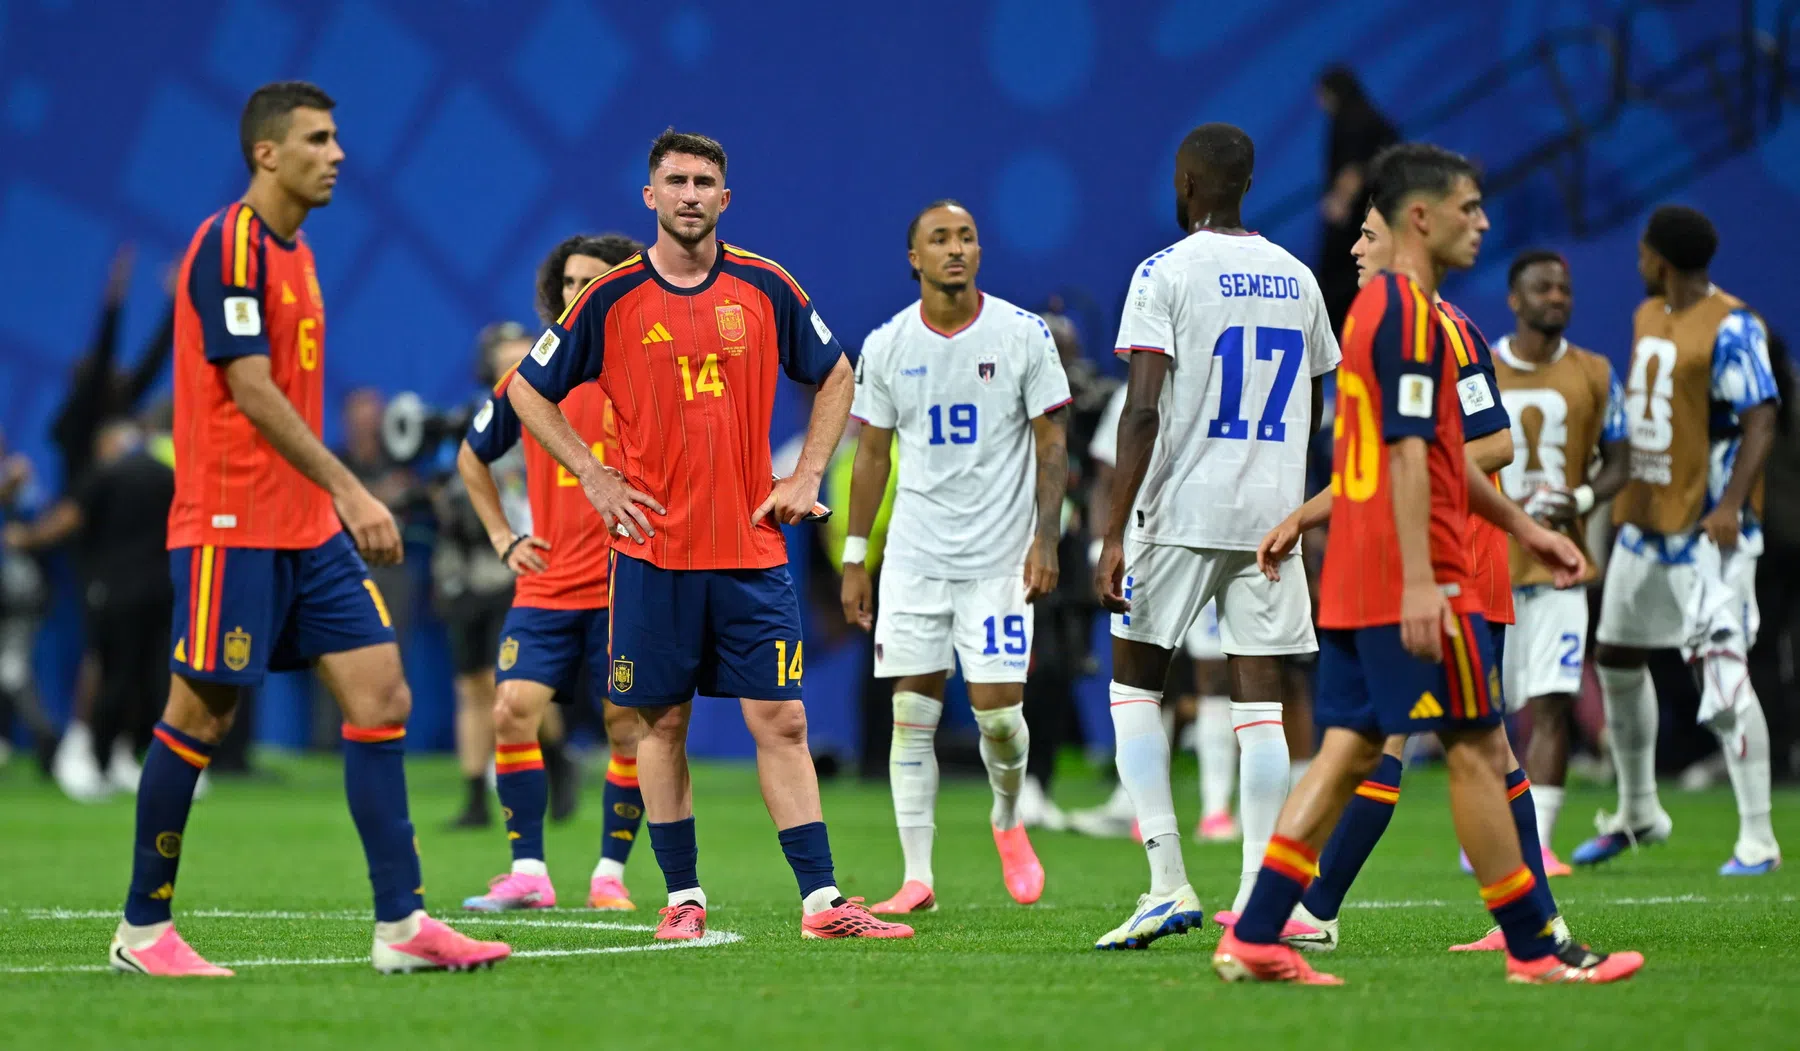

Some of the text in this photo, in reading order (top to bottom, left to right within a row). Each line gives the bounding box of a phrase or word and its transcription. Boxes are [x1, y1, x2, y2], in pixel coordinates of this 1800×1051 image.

[1219, 273, 1300, 300] SEMEDO
[677, 353, 725, 401] 14
[1207, 326, 1305, 442] 17
[928, 403, 977, 445] 19
[983, 615, 1027, 655] 19
[1560, 632, 1580, 667] 2
[775, 640, 803, 687] 14
